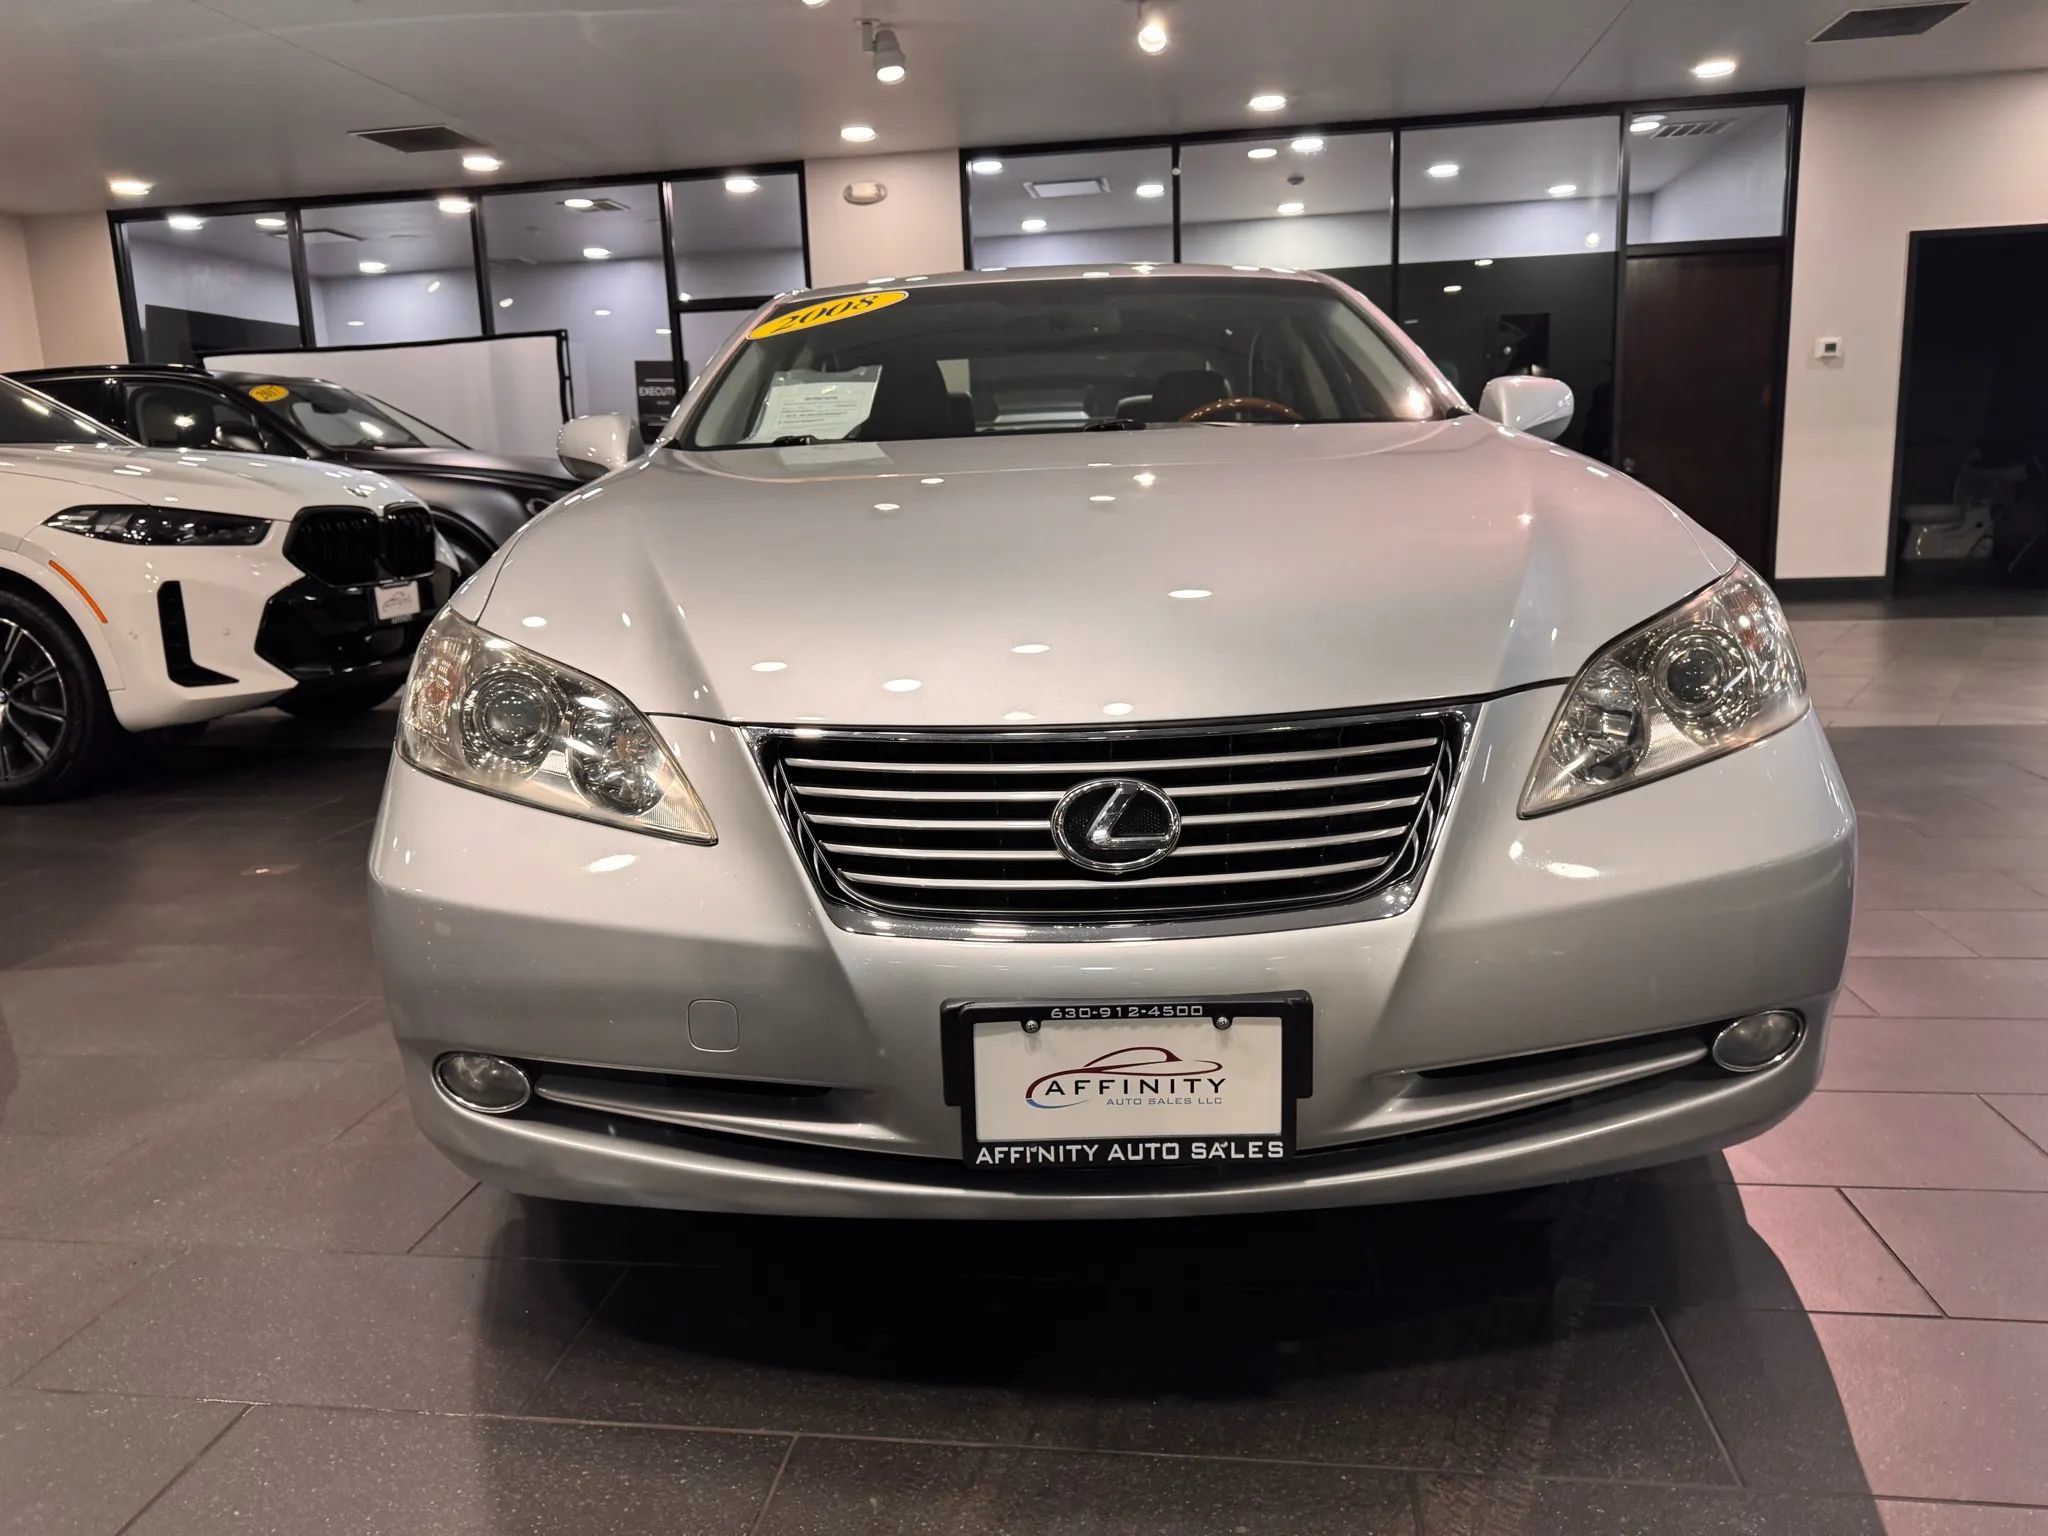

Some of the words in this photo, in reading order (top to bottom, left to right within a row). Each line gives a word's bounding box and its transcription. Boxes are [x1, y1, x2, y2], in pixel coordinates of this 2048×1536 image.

[770, 295, 879, 334] 2008
[1051, 1006, 1203, 1019] 630-912-4500
[1045, 1078, 1226, 1096] AFFINITY
[1106, 1098, 1142, 1106] AUTO
[1148, 1097, 1192, 1105] SALES
[1198, 1097, 1223, 1105] LLC
[976, 1145, 1099, 1164] AFFINITY
[1107, 1142, 1180, 1161] AUTO
[1191, 1141, 1284, 1160] SALES
